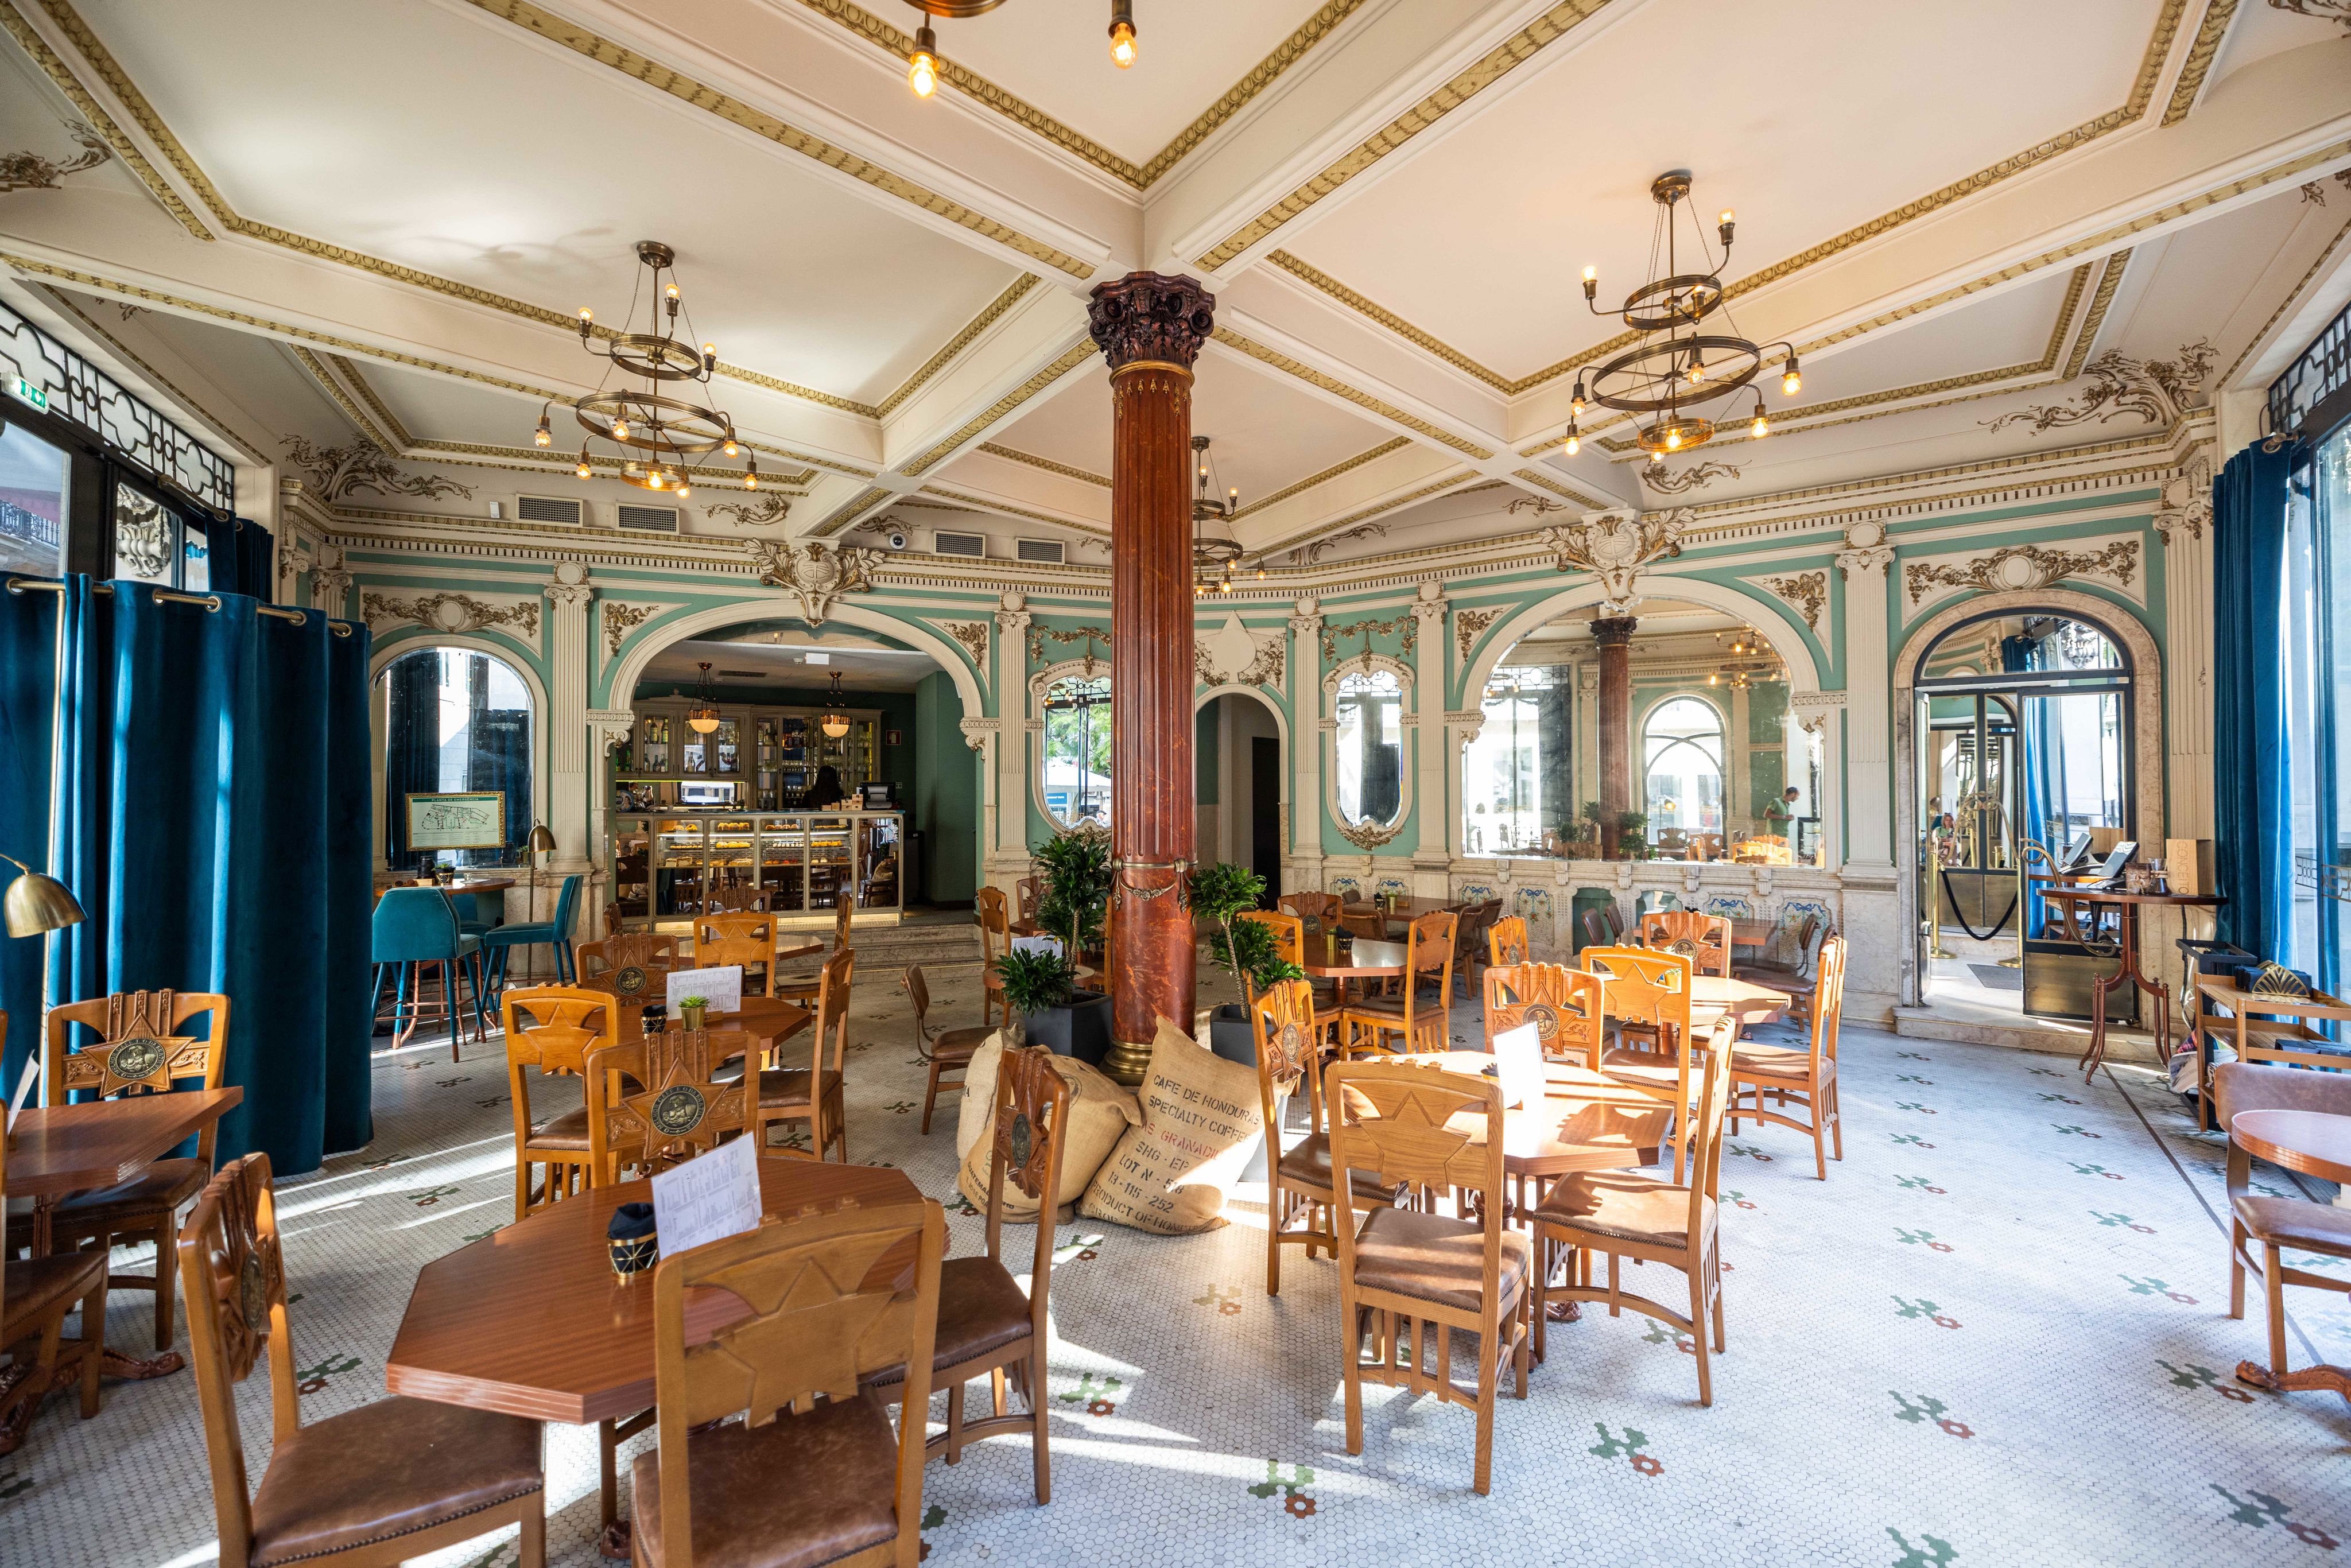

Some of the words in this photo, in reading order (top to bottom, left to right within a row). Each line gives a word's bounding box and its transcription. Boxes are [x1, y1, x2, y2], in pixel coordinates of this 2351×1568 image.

[2177, 841, 2189, 895] CONCEITO
[110, 1053, 121, 1074] MELHOR
[145, 1046, 164, 1075] BRAZILEIRA
[652, 1104, 664, 1130] MELHOR
[686, 1094, 704, 1130] BRAZILEIRA
[1154, 1074, 1181, 1095] CAFE
[1183, 1088, 1201, 1103] DE
[1202, 1095, 1261, 1125] HONDURAS
[1137, 1120, 1155, 1136] AS
[1149, 1095, 1208, 1128] SPECIALTY
[1209, 1120, 1251, 1143] COFFEE
[1119, 1154, 1140, 1173] LOT
[1140, 1169, 1154, 1181] N
[1135, 1141, 1161, 1161] SHG
[1169, 1157, 1189, 1171] EP
[967, 1161, 990, 1196] GUATEMA
[1108, 1171, 1119, 1185] 13
[1124, 1182, 1142, 1198] 115
[1149, 1196, 1174, 1213] 252
[1093, 1180, 1134, 1217] PRODUCT
[1135, 1211, 1153, 1224] OF
